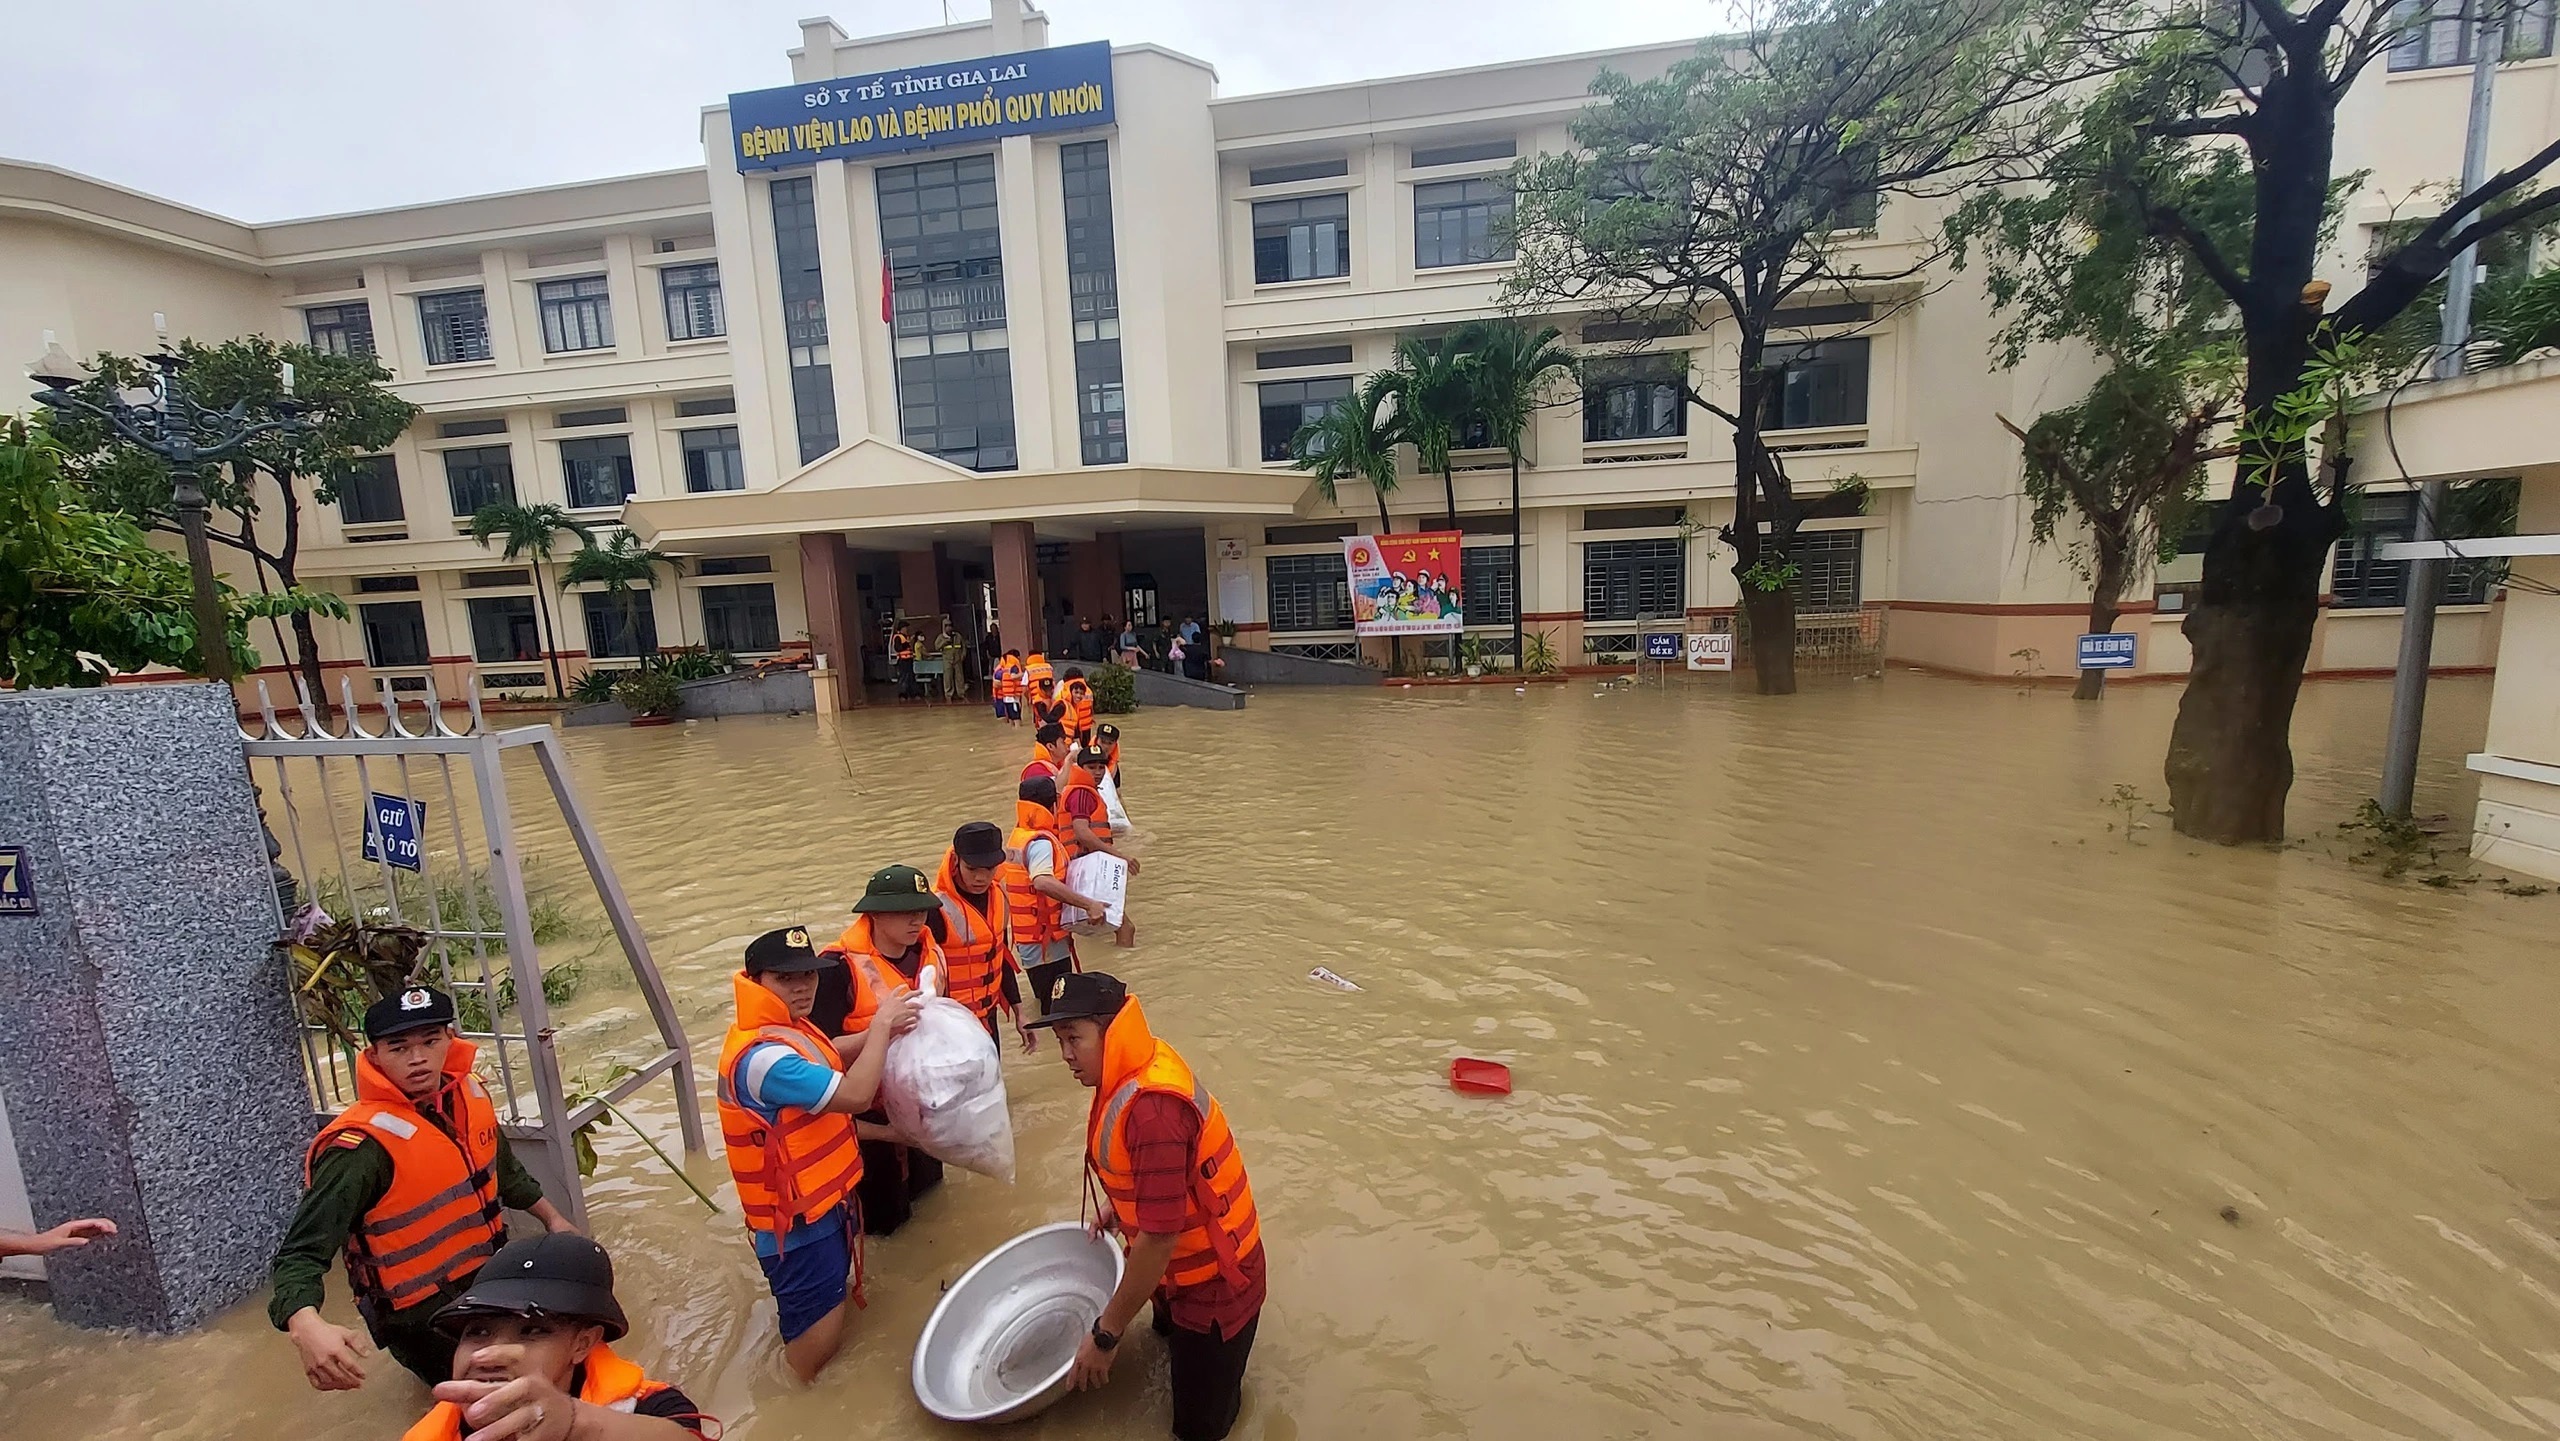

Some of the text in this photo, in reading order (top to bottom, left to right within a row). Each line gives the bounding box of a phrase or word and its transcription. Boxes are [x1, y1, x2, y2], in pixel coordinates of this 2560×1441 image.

[804, 63, 1028, 108] SỞ Y TẾ TỈNH GIA LAI
[741, 81, 1102, 161] BỆNH VIỆN LAO VÀ BỆNH PHỔI QUY NHƠN
[1662, 647, 1673, 655] XE
[380, 808, 405, 827] GIỮ
[387, 833, 395, 852] Ô
[399, 838, 418, 858] TÔ
[1112, 863, 1121, 891] Select
